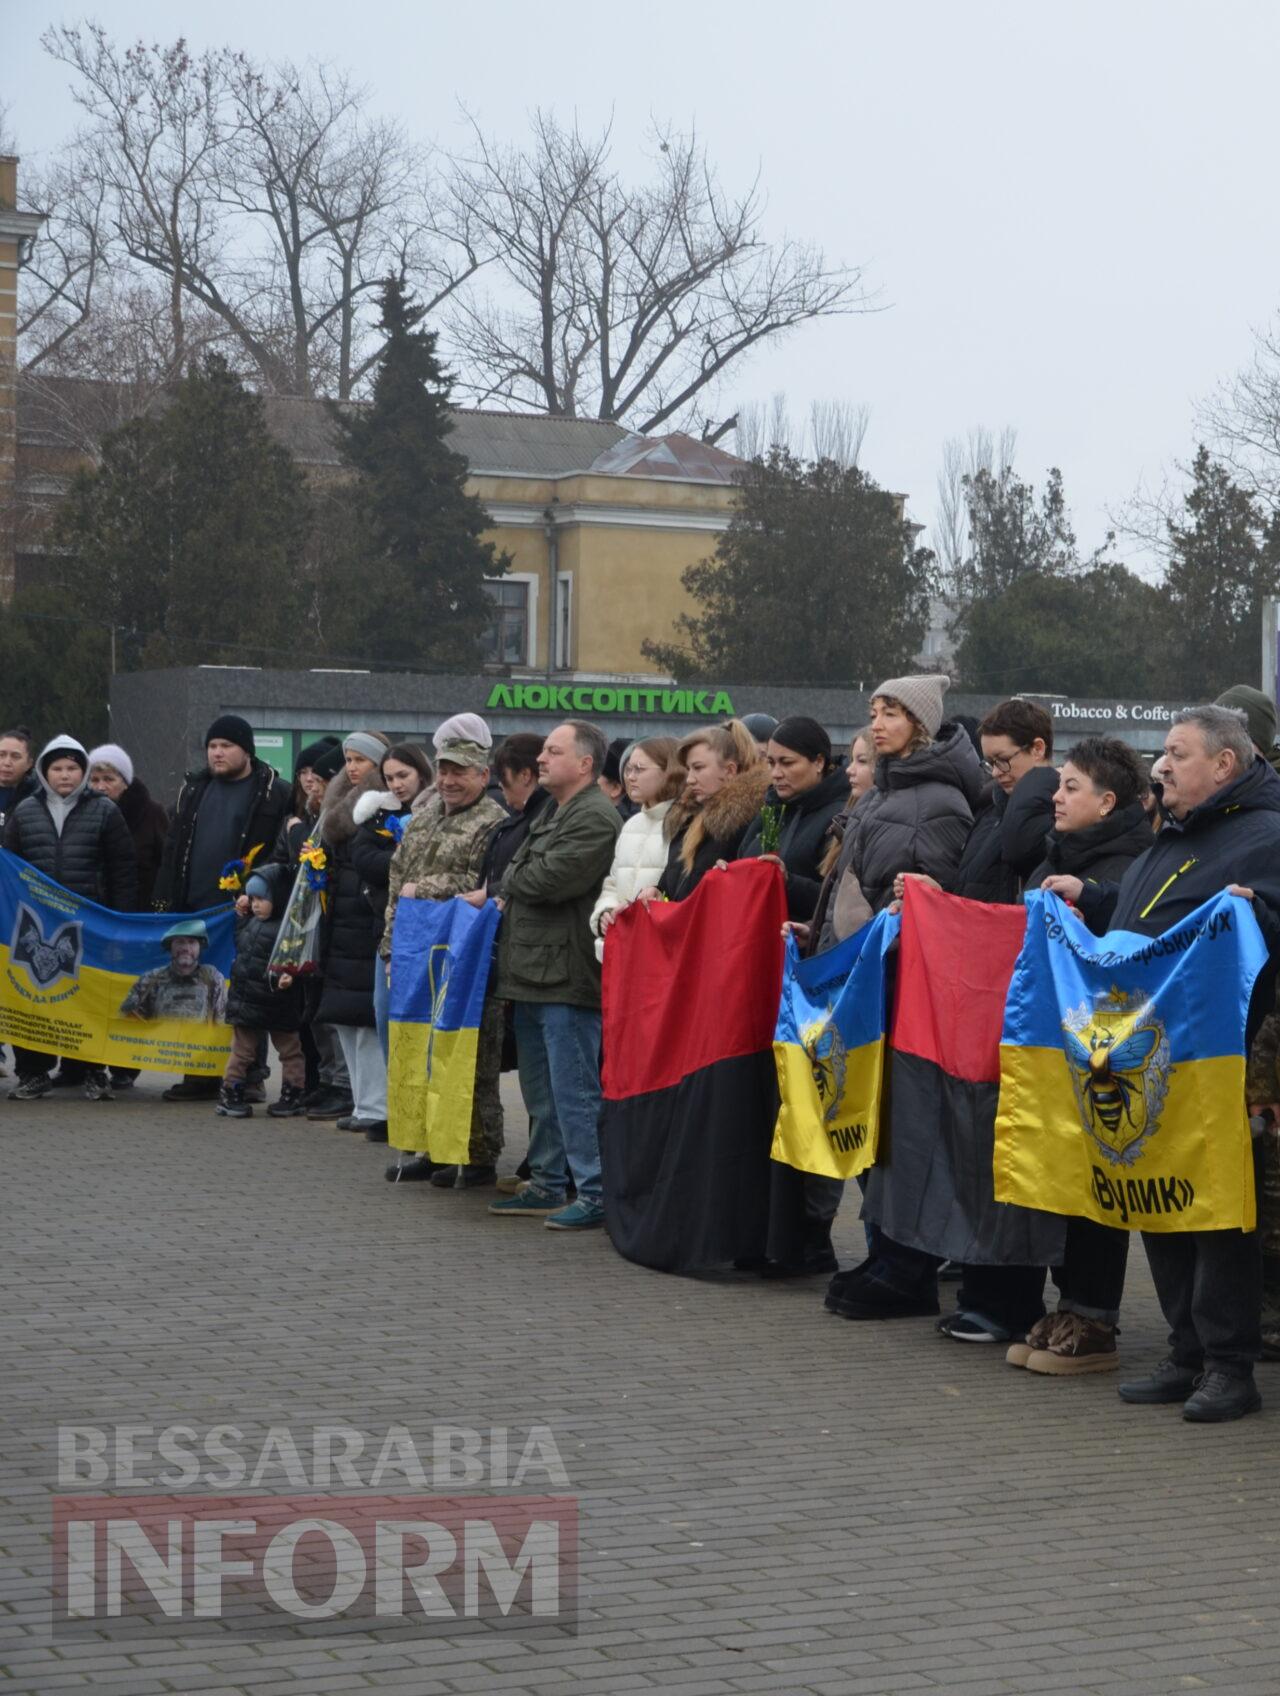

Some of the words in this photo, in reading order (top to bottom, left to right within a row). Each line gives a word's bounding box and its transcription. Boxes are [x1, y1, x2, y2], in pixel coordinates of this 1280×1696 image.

[487, 683, 735, 715] ЛЮКСОПТИКА
[1052, 703, 1112, 719] Tobacco
[1115, 704, 1128, 719] &
